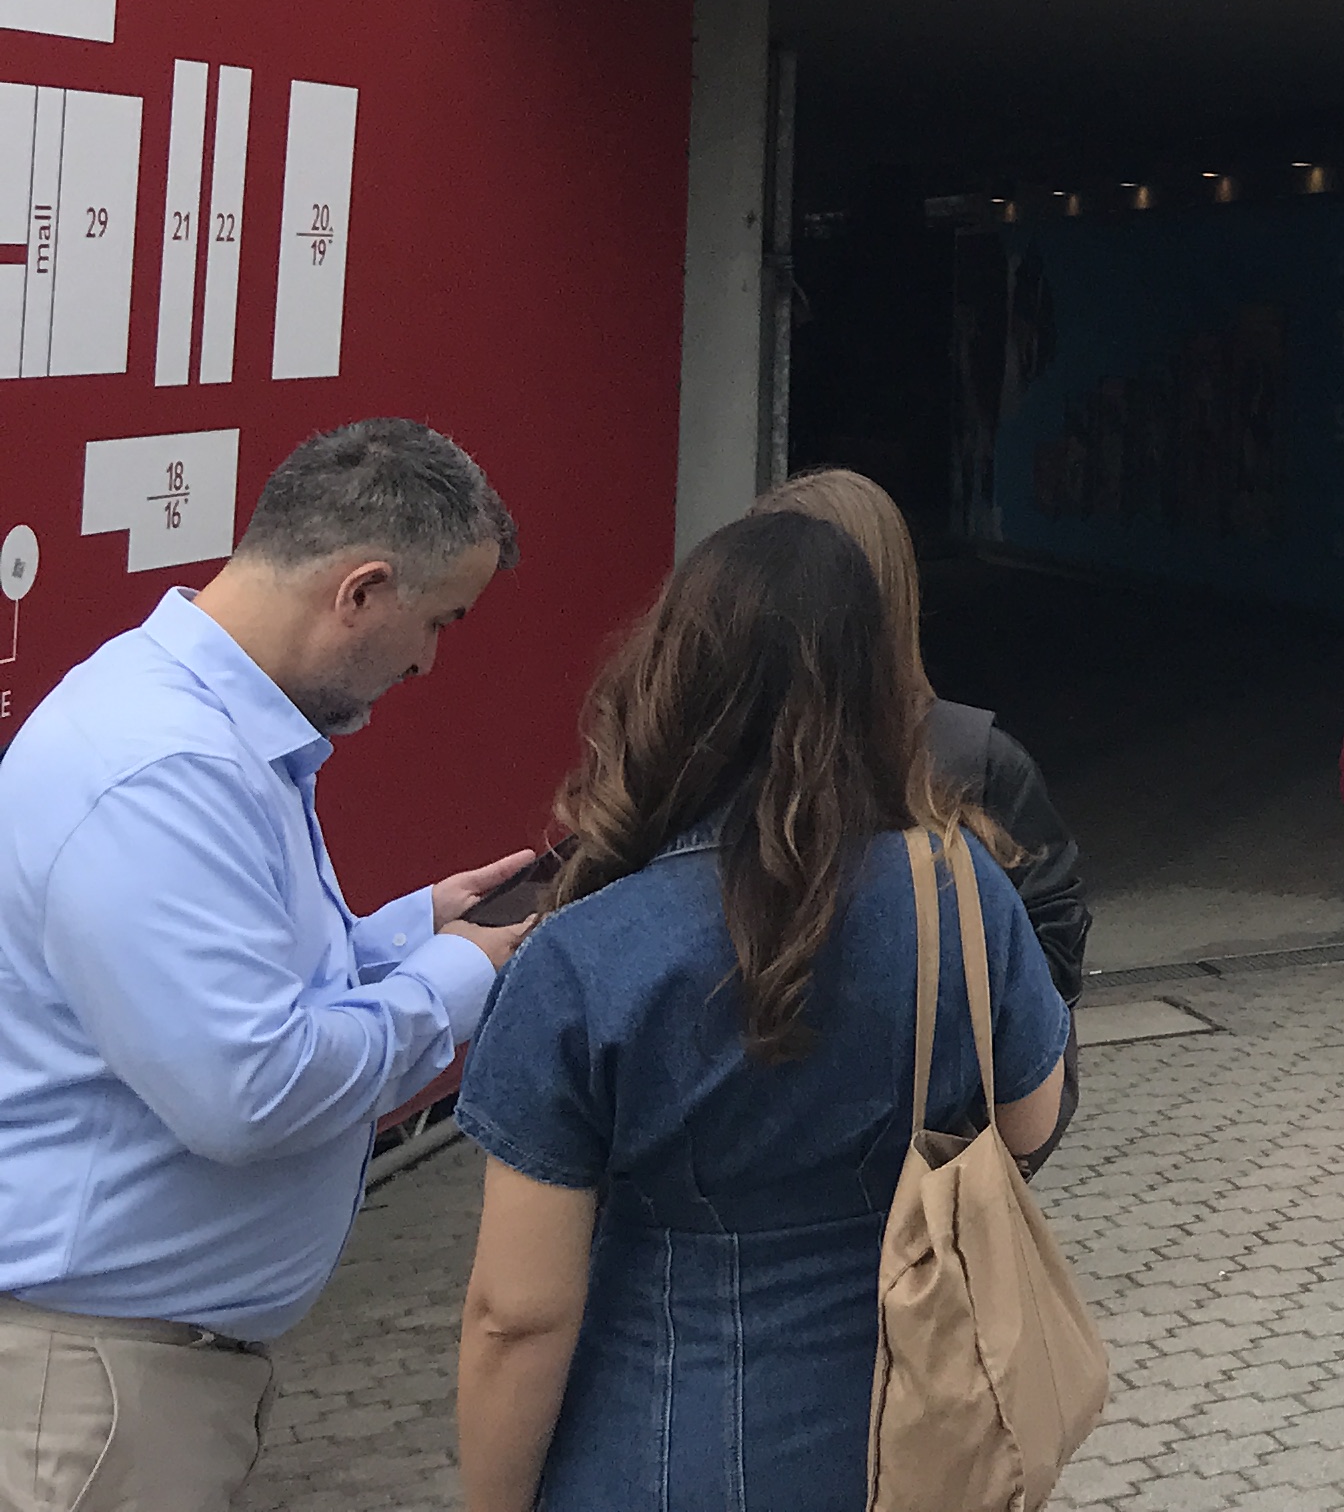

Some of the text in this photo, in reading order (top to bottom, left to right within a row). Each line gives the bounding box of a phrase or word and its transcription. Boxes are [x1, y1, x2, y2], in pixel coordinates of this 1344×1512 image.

[86, 207, 108, 238] 29
[172, 211, 190, 241] 21
[215, 213, 236, 242] 22
[312, 203, 330, 231] 20
[35, 204, 52, 274] mall
[311, 239, 327, 266] 19
[166, 460, 184, 491] 18
[164, 500, 182, 529] 16
